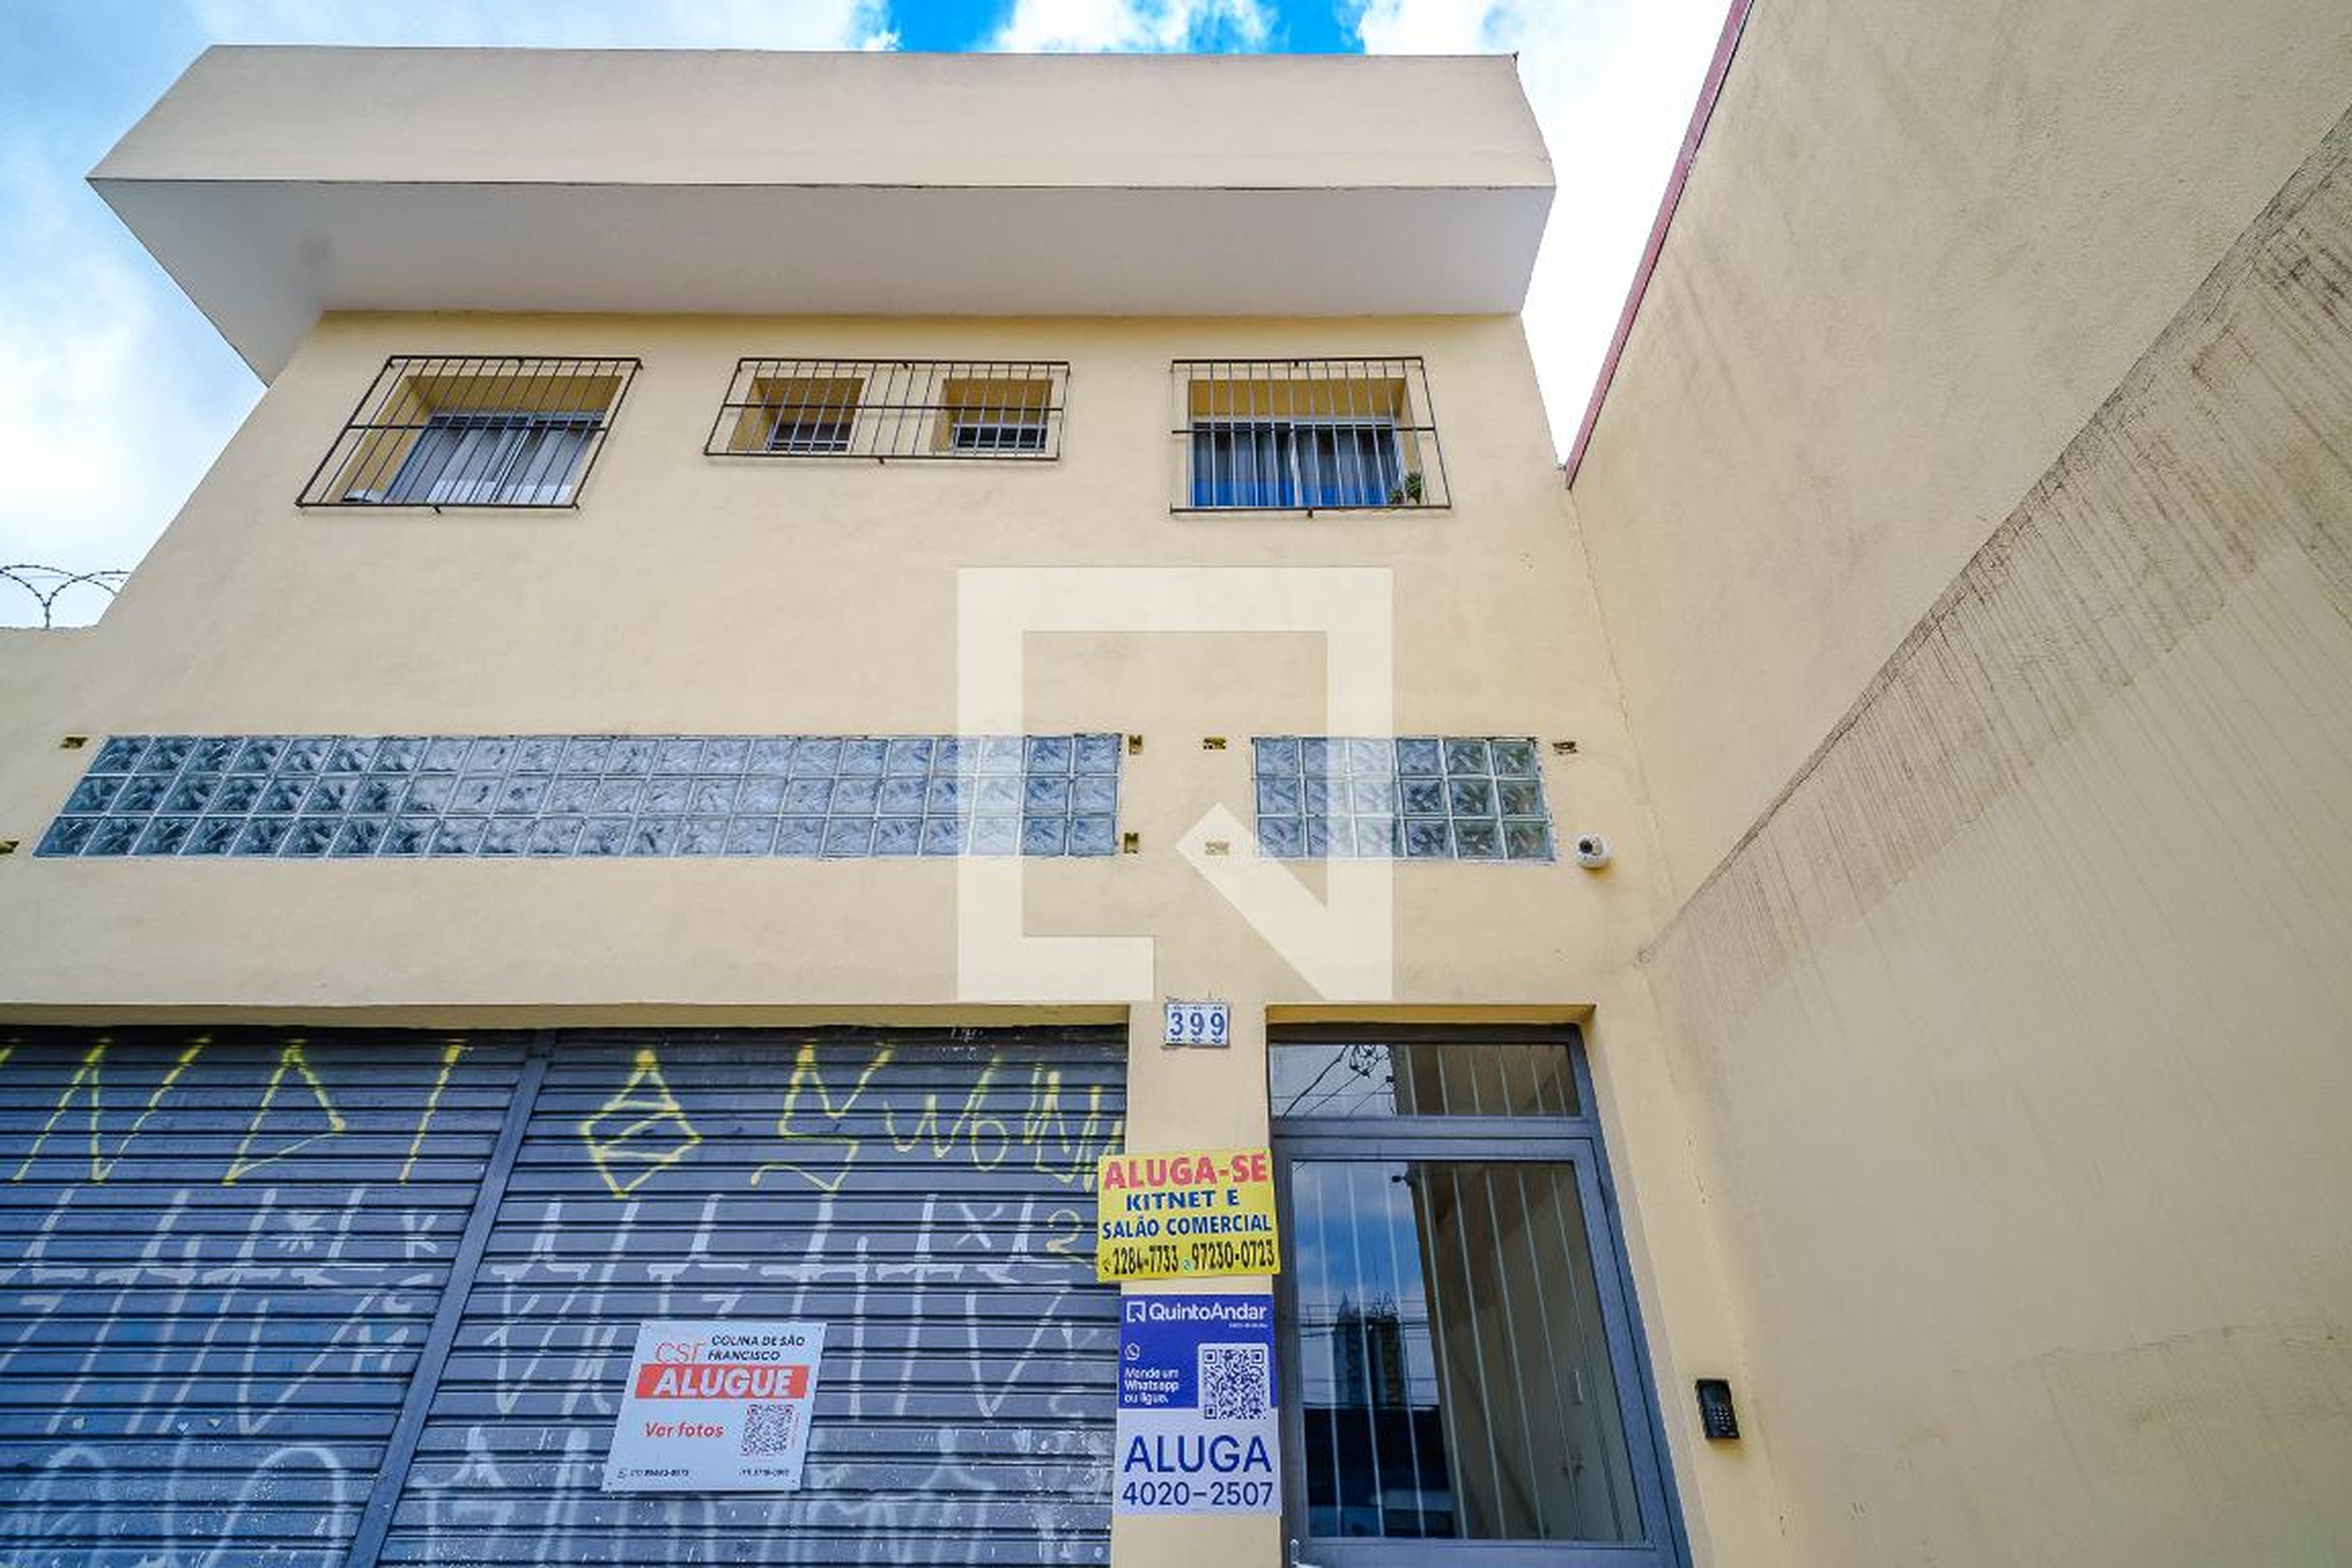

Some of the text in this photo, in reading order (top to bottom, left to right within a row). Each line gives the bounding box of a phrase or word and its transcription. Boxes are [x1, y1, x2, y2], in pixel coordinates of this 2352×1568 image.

[1170, 1012, 1225, 1036] 399
[1103, 1153, 1268, 1189] ALUGA-SE
[1126, 1189, 1239, 1211] KITNET E
[1102, 1215, 1272, 1238] SALÃO COMERCIAL
[1192, 1240, 1275, 1270] 97230-0723
[1149, 1302, 1267, 1321] QuintoAndar
[711, 1333, 805, 1346] COLINA DE SÃO
[707, 1351, 780, 1361] FRANCISCO
[653, 1368, 794, 1396] ALUGUE
[677, 1422, 724, 1438] fotos
[1124, 1435, 1272, 1472] ALUGA
[1123, 1482, 1273, 1506] 4020-2507
